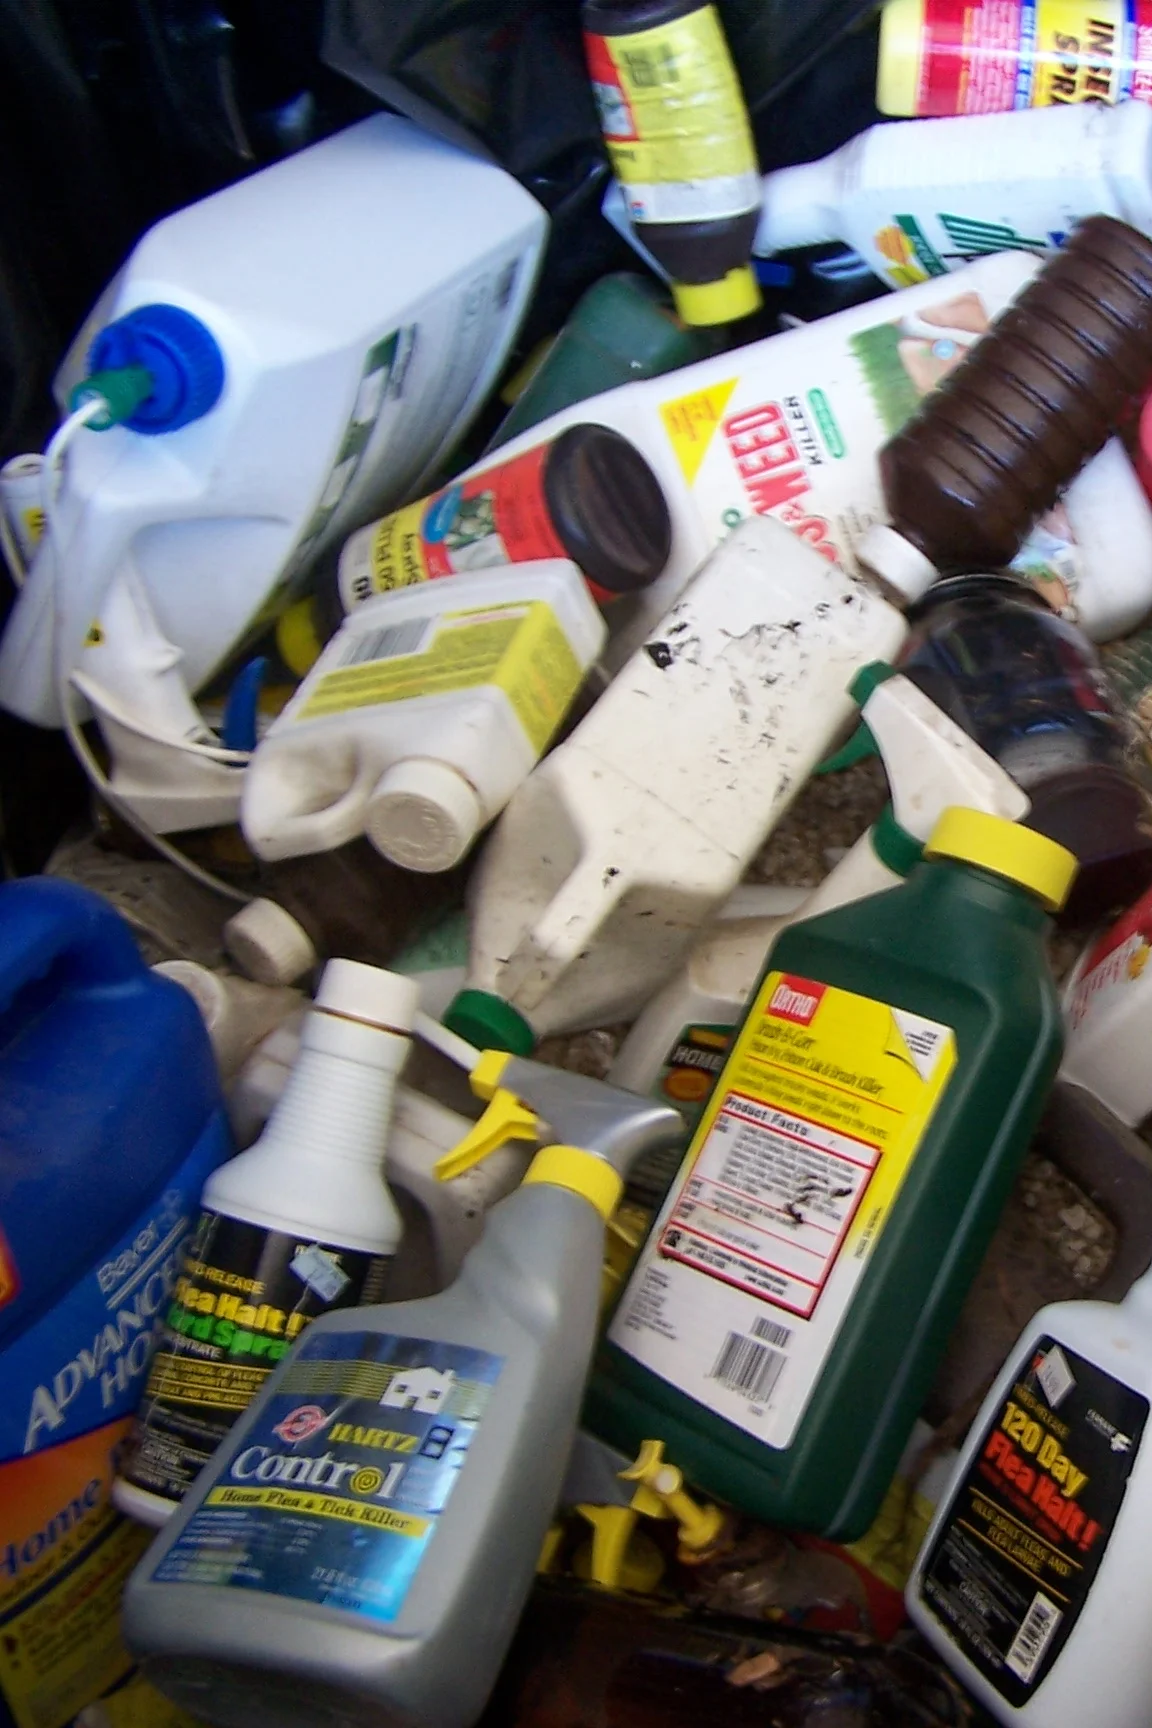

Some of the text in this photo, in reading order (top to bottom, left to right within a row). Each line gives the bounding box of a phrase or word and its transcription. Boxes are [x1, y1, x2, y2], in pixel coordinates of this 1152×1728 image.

[721, 401, 812, 514] WEED
[783, 395, 824, 466] KILLER
[769, 984, 816, 1021] ORTHO
[724, 1096, 810, 1137] Product Facts
[213, 1318, 298, 1362] Spra
[326, 1421, 421, 1455] HARTZ
[983, 1430, 1038, 1490] Flea
[1001, 1401, 1042, 1455] 120
[1036, 1435, 1089, 1498] Day
[229, 1445, 408, 1499] Control
